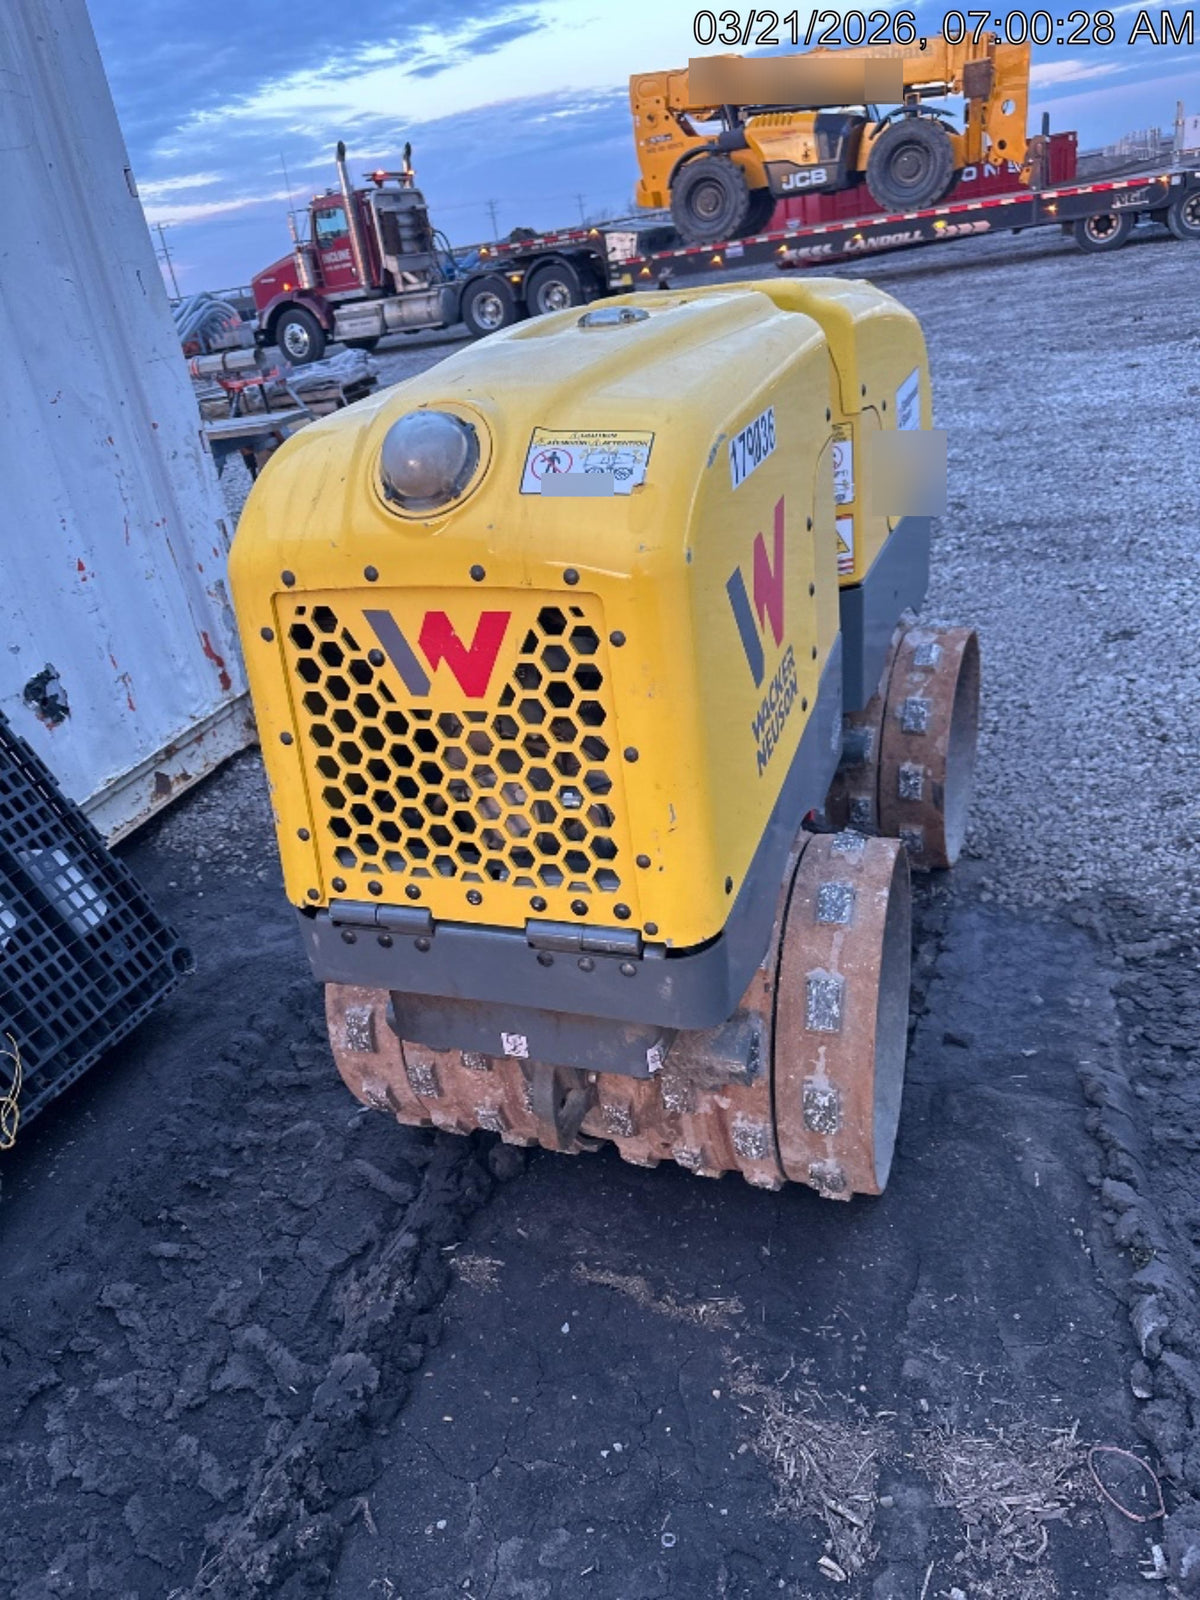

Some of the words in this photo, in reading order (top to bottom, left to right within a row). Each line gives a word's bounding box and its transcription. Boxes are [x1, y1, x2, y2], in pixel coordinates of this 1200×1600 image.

[781, 168, 827, 190] JCB
[842, 230, 924, 251] LANDOLL
[752, 644, 796, 744] WACKER
[757, 669, 799, 779] NEUSON
